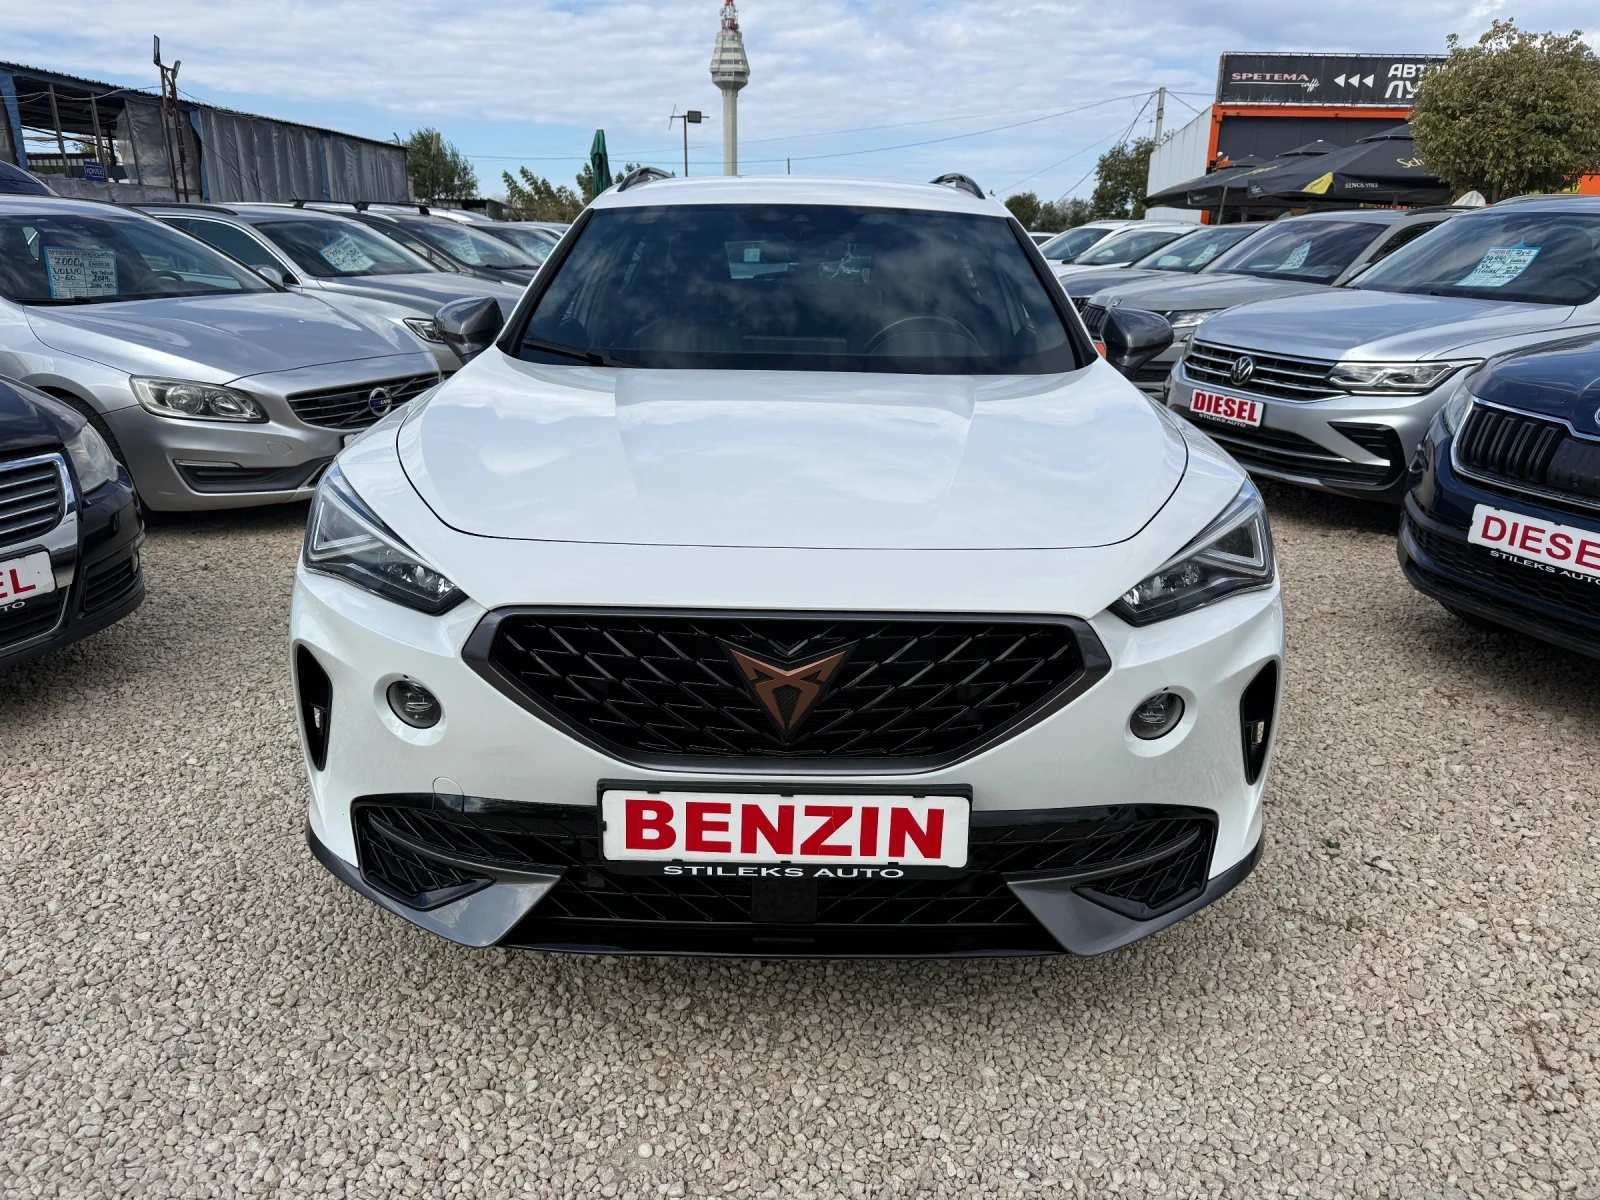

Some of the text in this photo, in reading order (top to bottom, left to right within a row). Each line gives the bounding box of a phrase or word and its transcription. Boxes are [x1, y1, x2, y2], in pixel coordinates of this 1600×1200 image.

[1231, 72, 1310, 81] SPETEMA
[1396, 157, 1425, 168] Sch
[52, 267, 82, 275] VOLVO
[1193, 391, 1258, 423] DIESEL
[1198, 413, 1247, 428] STILEKS AUTO
[1481, 515, 1600, 571] DIESE
[1489, 550, 1556, 573] STILEKS
[624, 798, 945, 859] BENZIN
[663, 865, 904, 879] STILEKS AUTO
